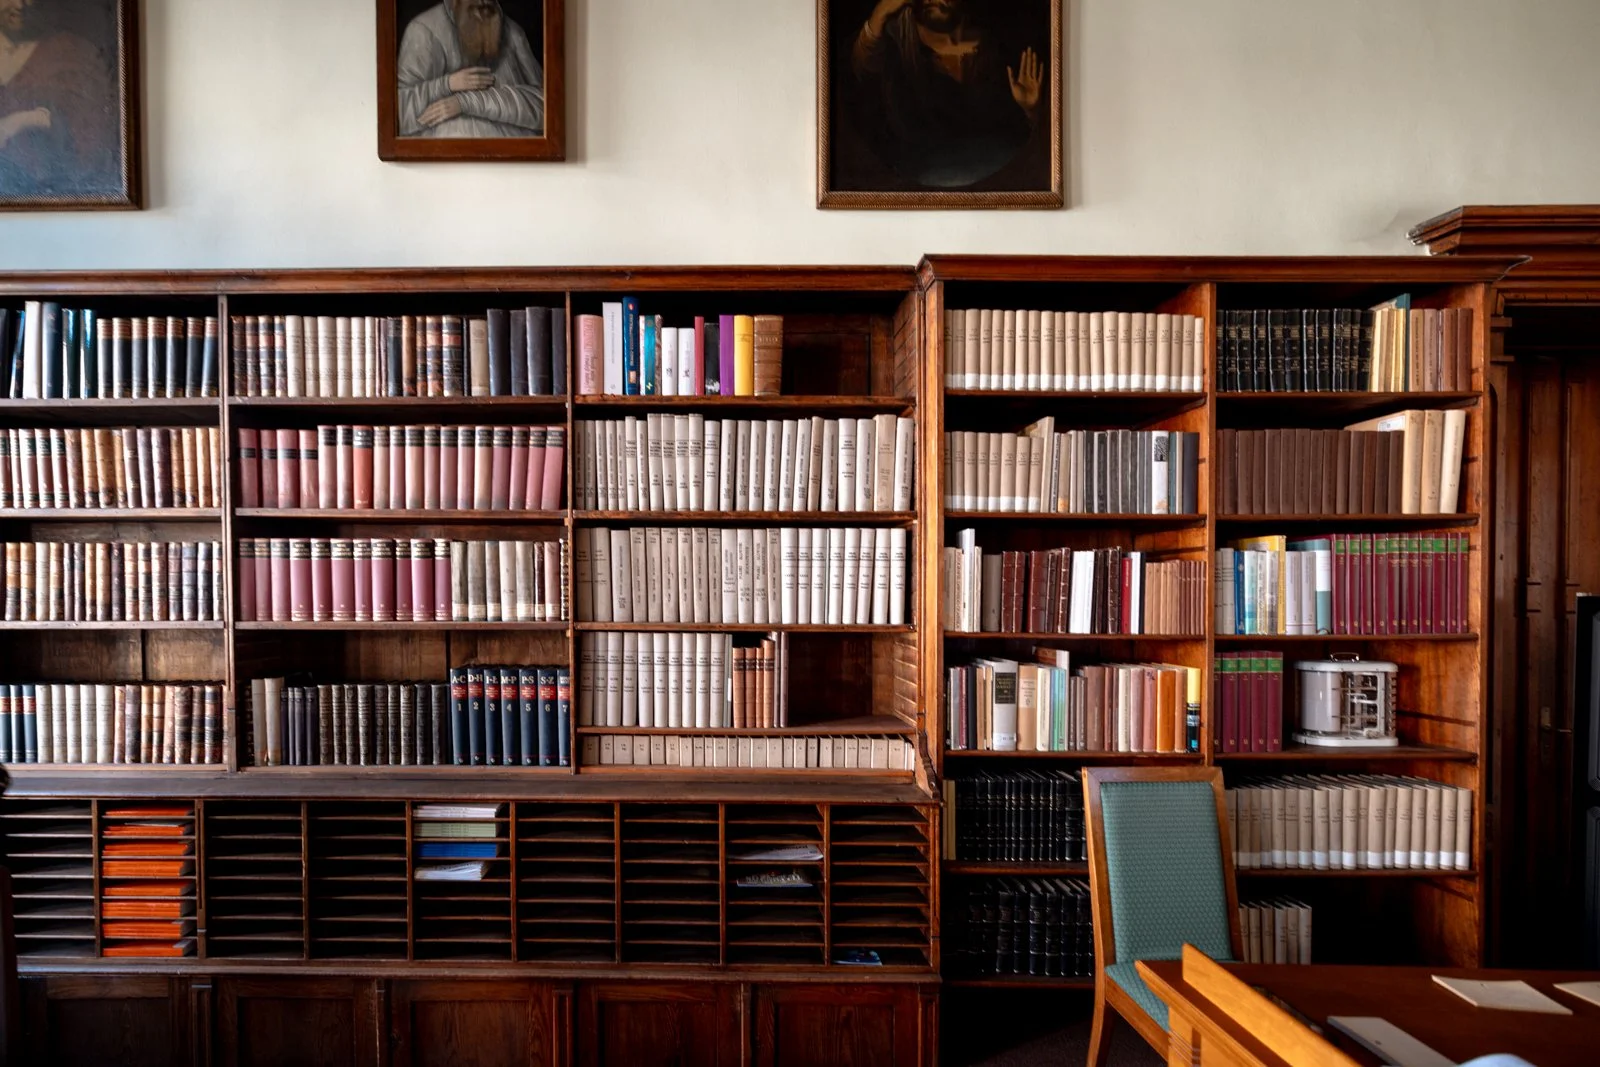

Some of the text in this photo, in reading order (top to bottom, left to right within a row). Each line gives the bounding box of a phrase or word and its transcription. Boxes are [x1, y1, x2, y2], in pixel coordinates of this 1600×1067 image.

[473, 701, 479, 710] 2
[489, 703, 495, 711] 3
[506, 703, 512, 711] 4
[525, 703, 531, 712] 5
[544, 704, 551, 712] 6
[562, 704, 568, 713] 7
